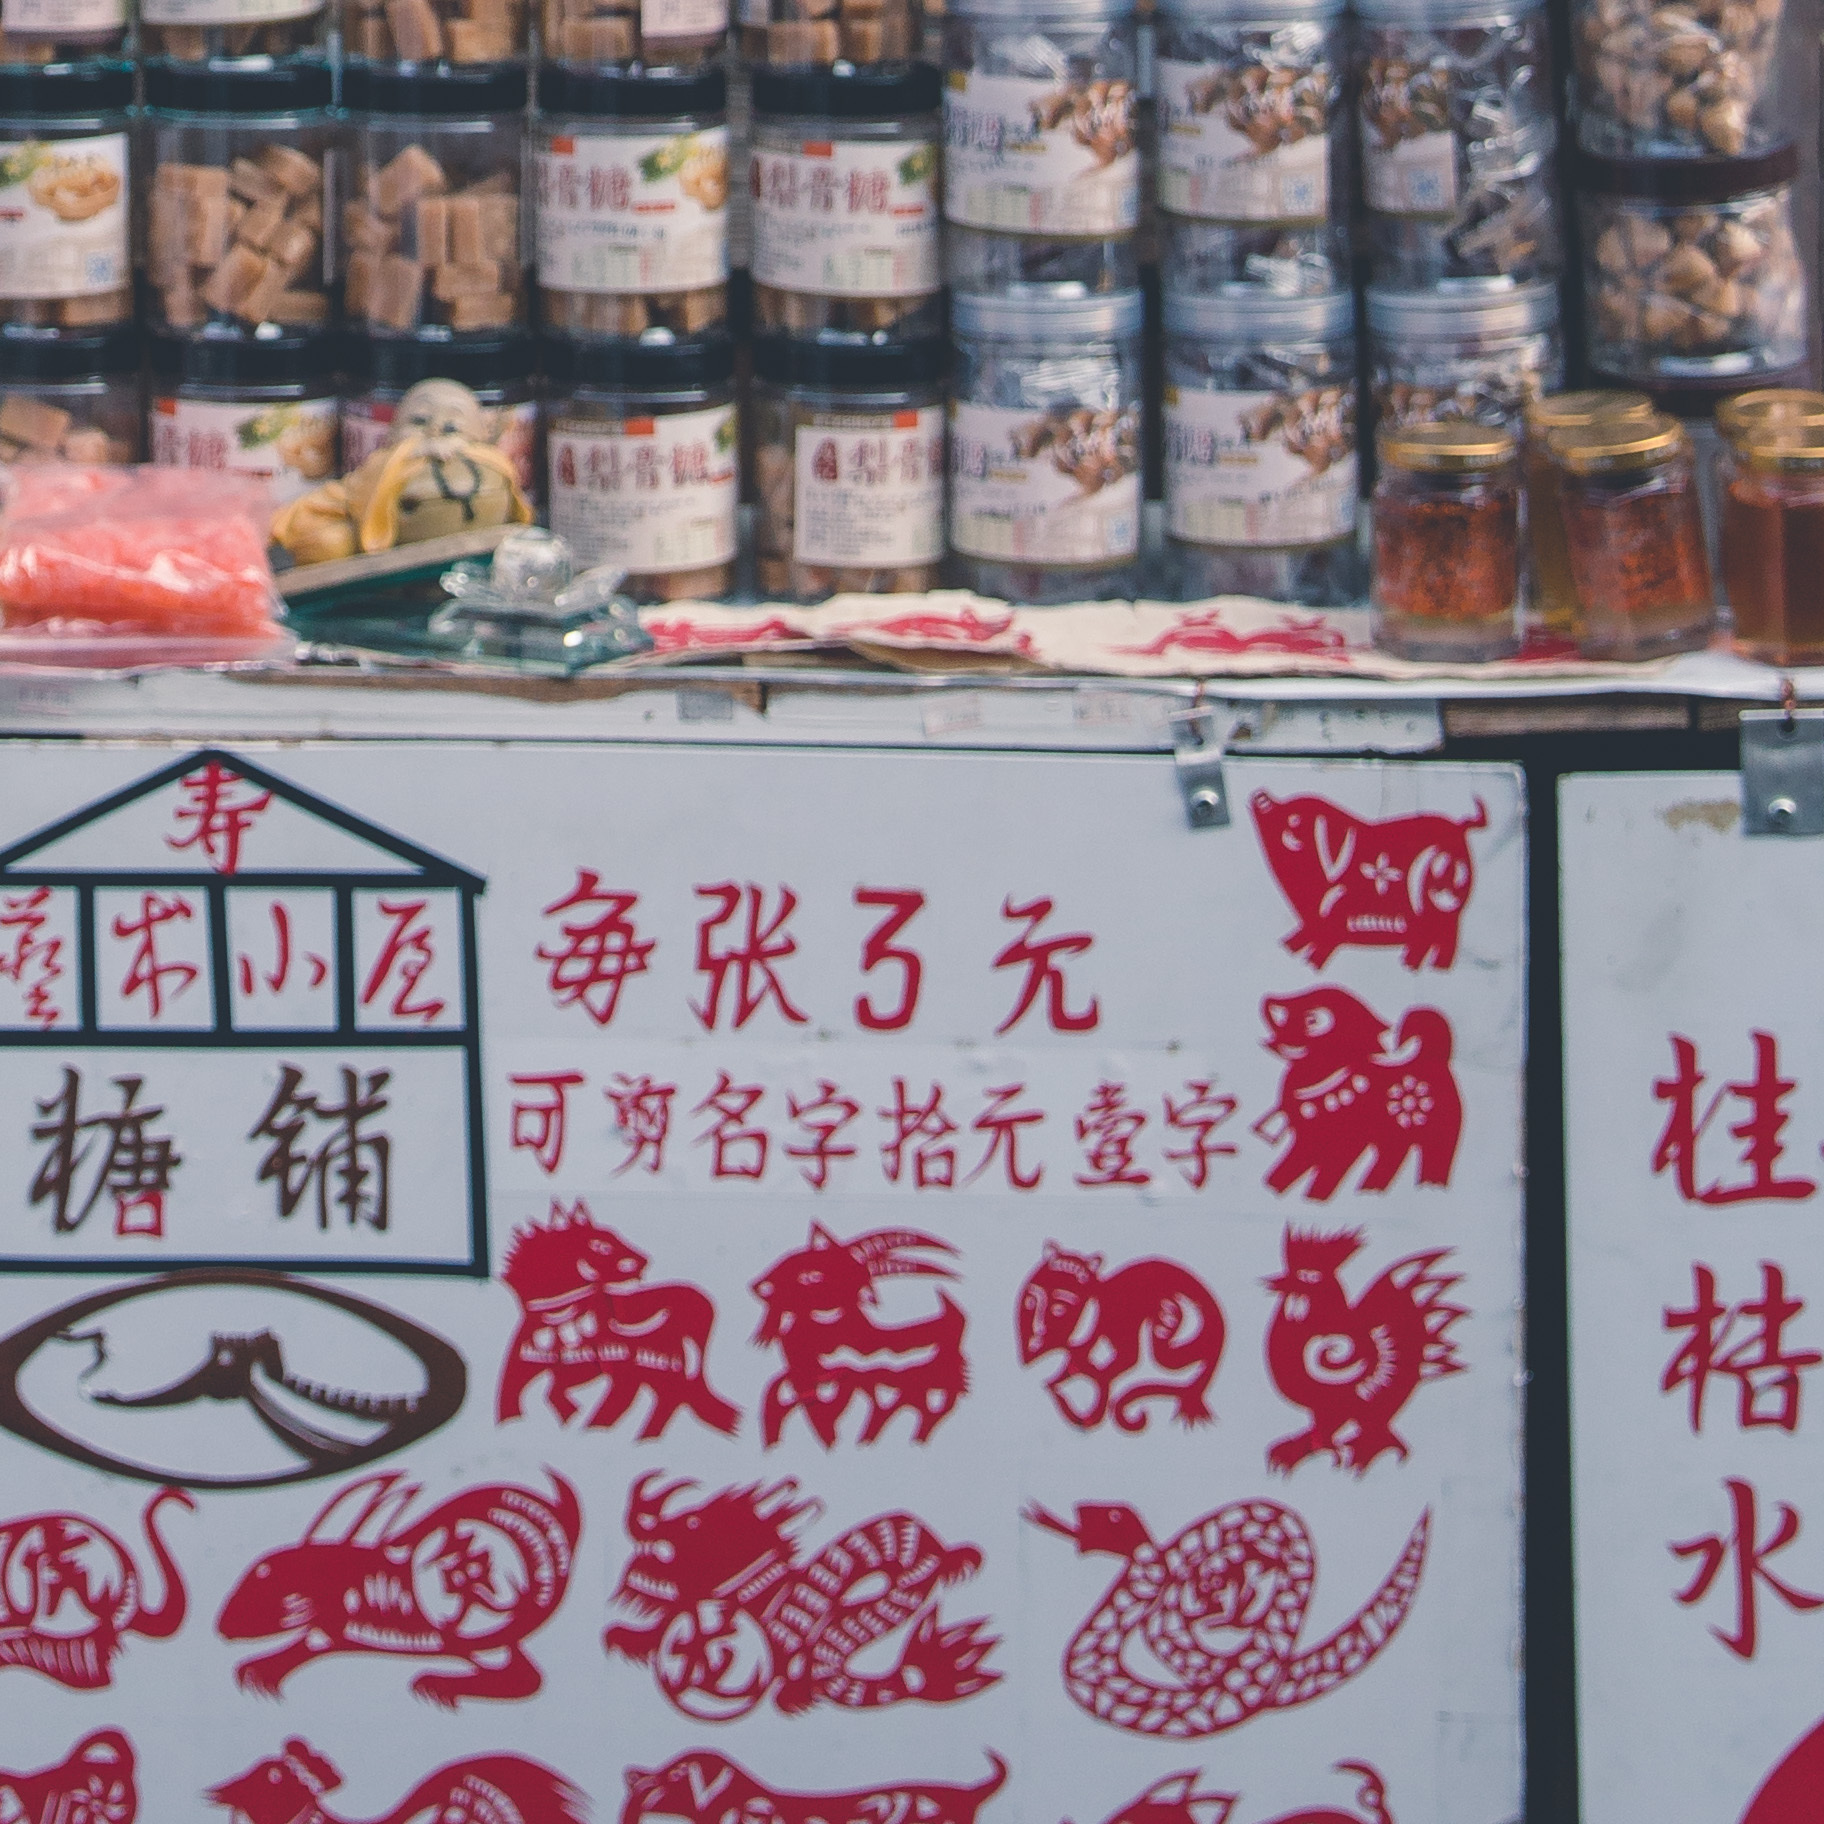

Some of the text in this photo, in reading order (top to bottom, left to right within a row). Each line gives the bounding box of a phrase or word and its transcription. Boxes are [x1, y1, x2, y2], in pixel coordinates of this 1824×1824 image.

[166, 758, 276, 877] 寿
[27, 1064, 394, 1237] 糖铺
[508, 1069, 1240, 1191] 可剪名字拾元壹字
